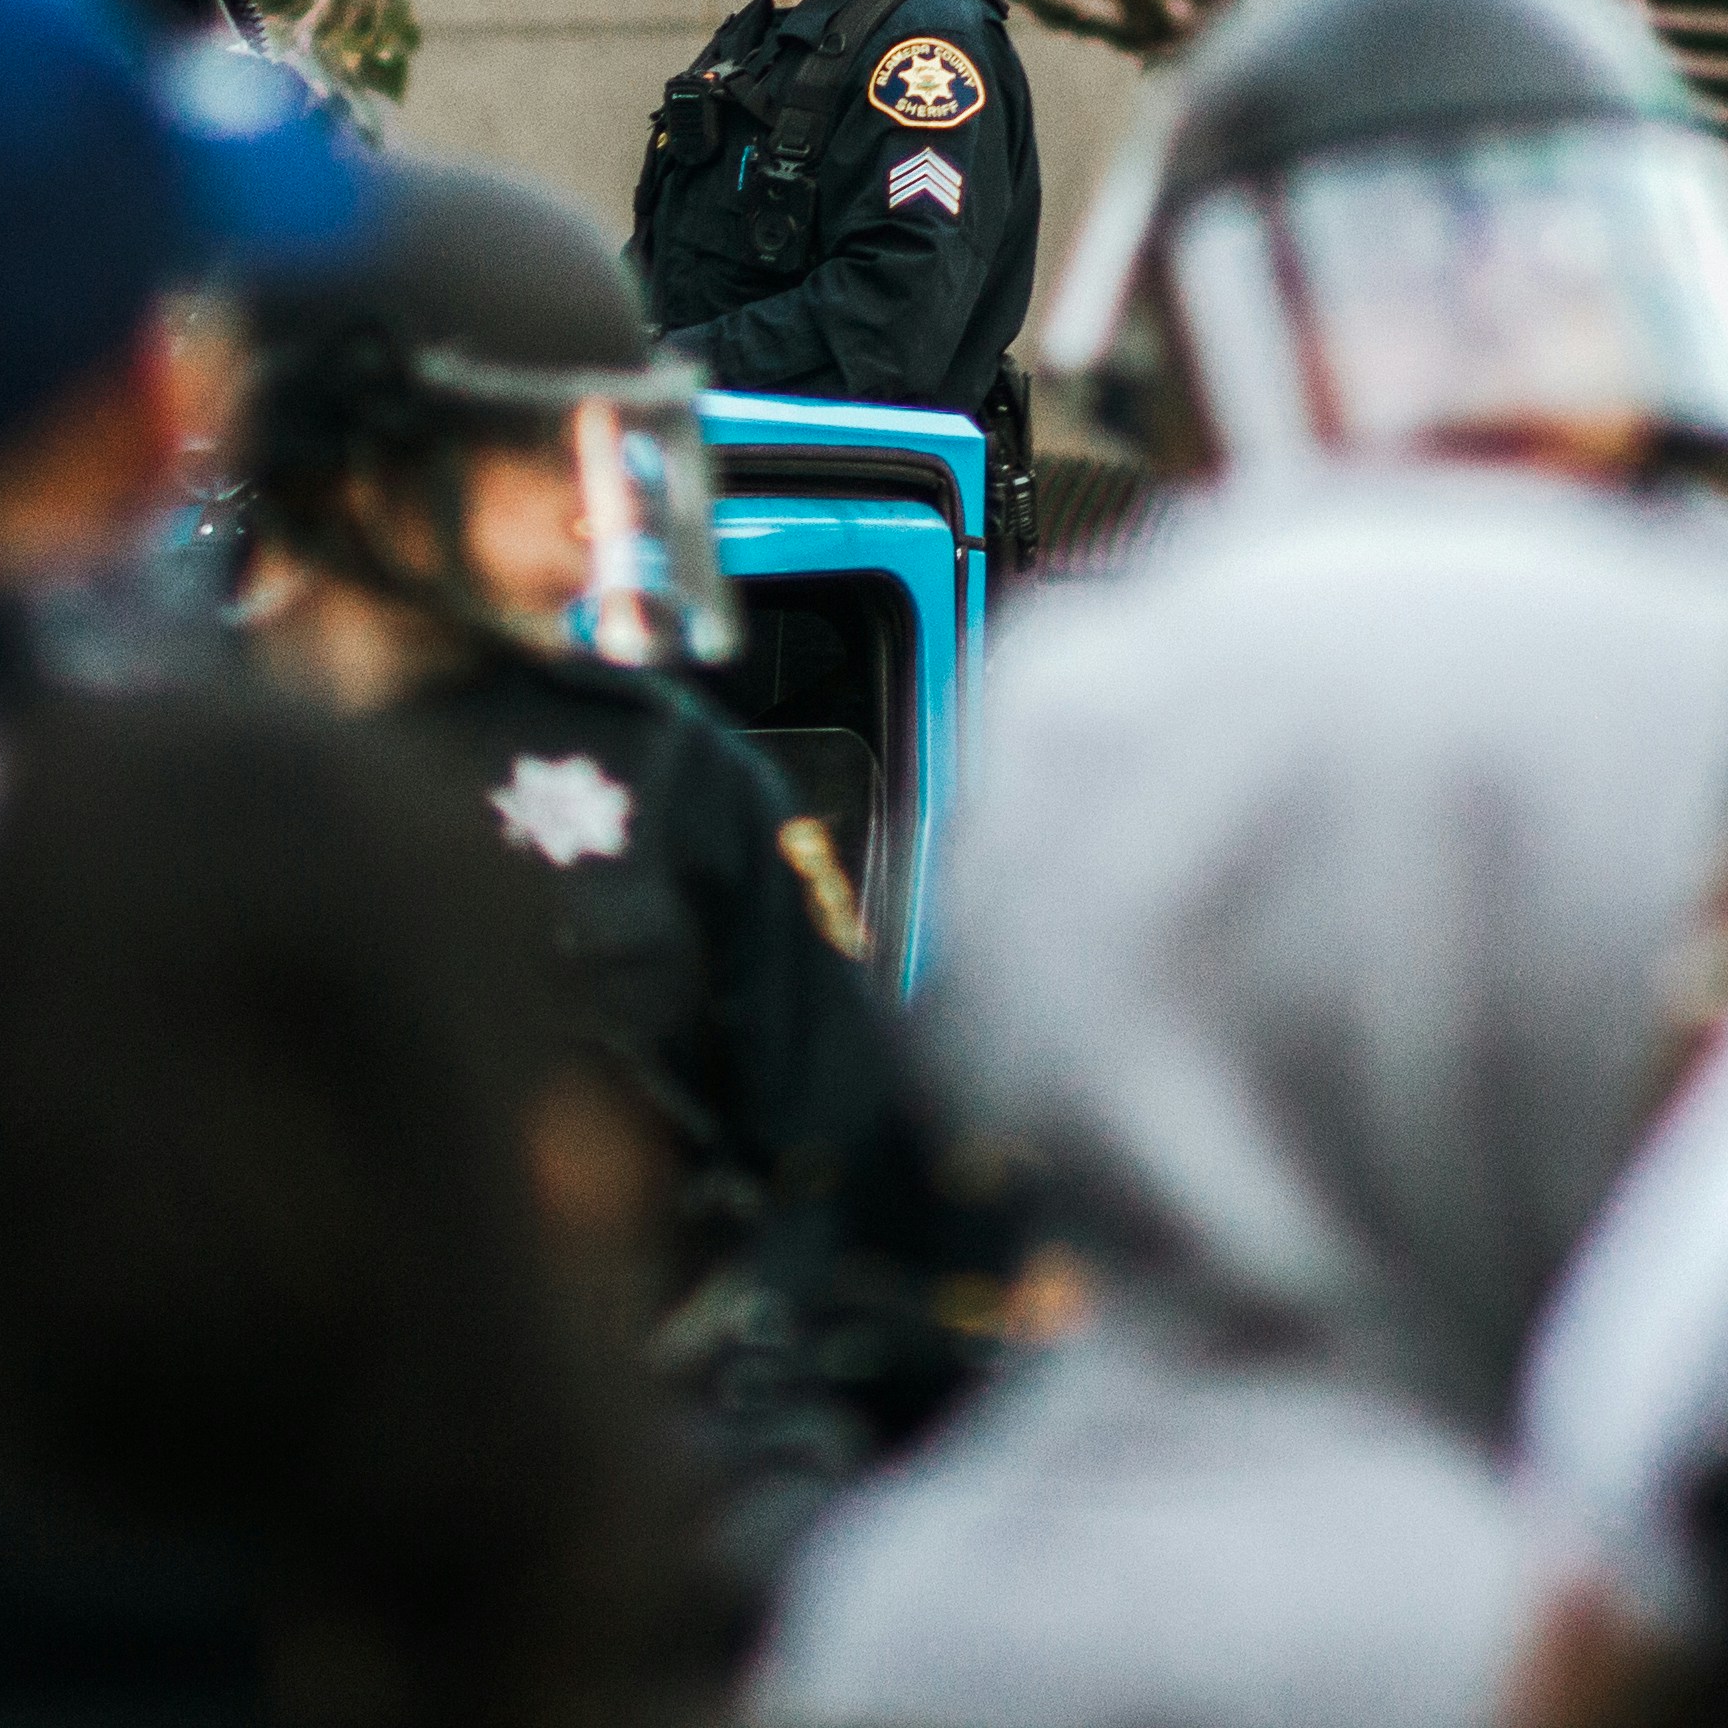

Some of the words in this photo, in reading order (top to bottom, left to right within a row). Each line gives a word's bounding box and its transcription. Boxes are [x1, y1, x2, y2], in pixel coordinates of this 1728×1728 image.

[875, 44, 931, 86] ALAMEDA
[933, 46, 977, 87] COUNTY
[895, 97, 959, 118] SHERIFF
